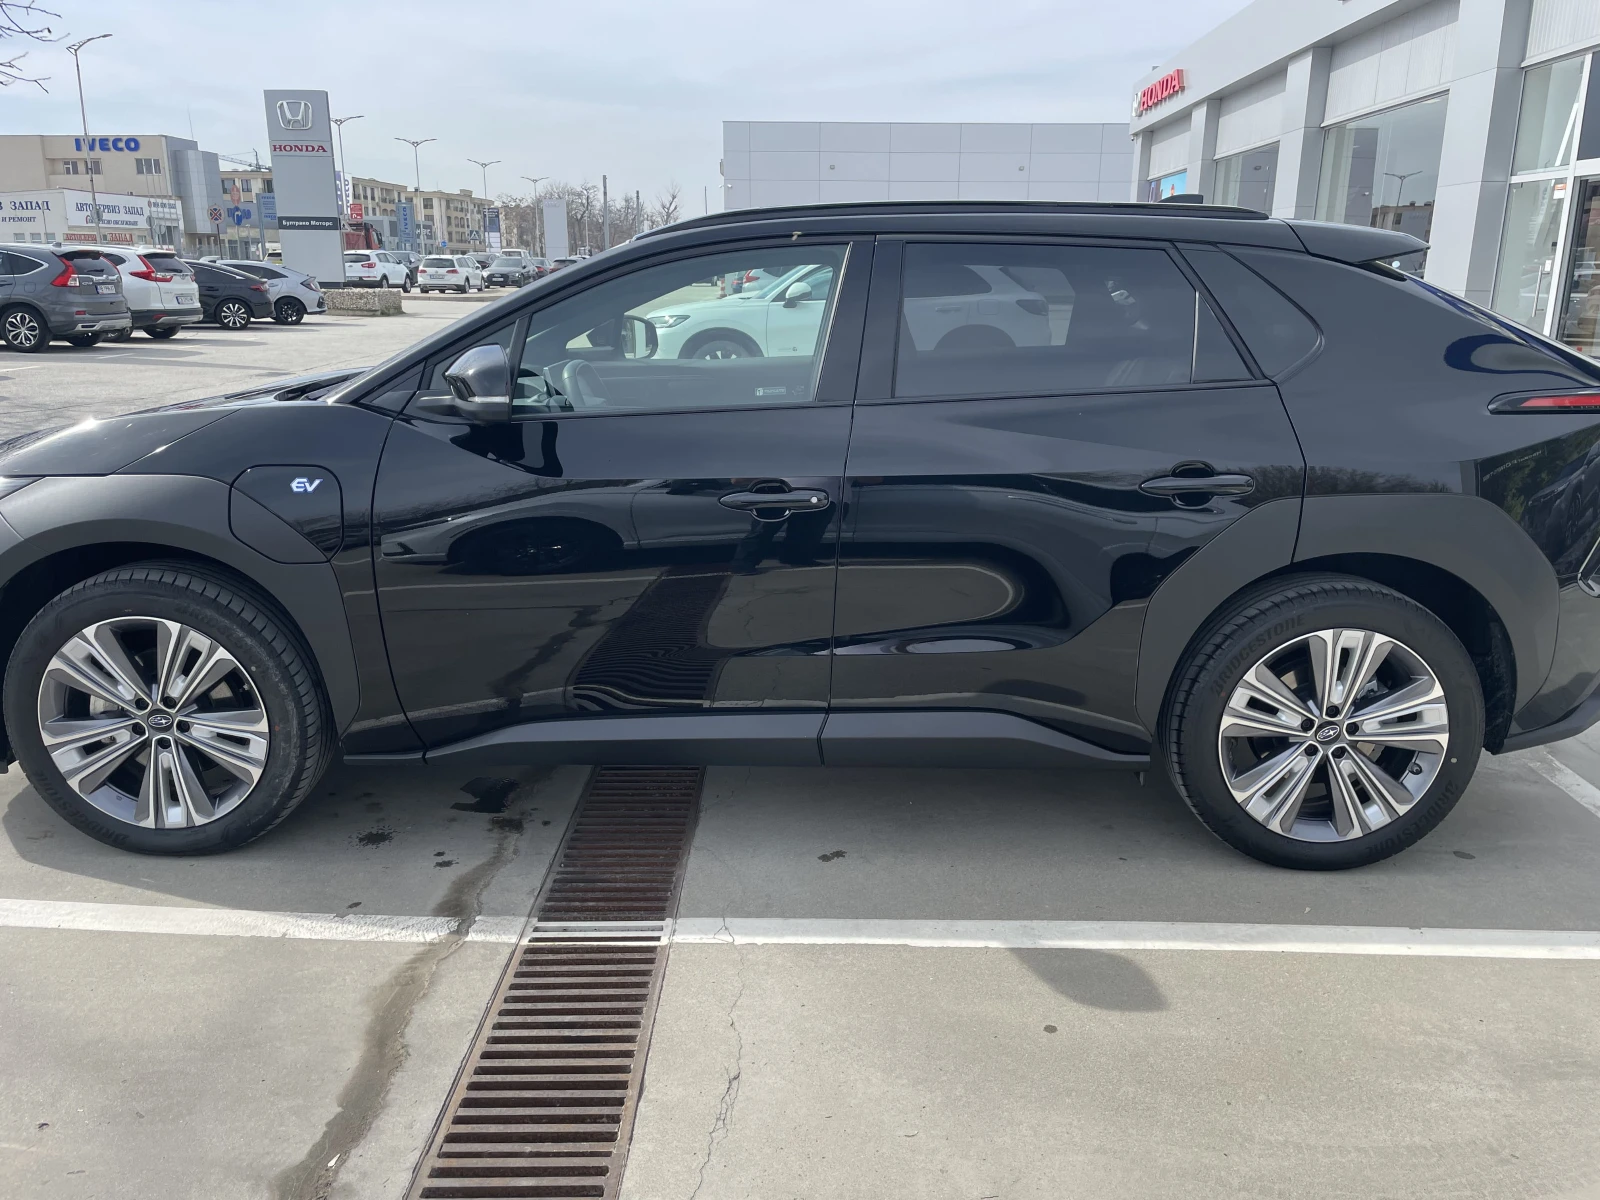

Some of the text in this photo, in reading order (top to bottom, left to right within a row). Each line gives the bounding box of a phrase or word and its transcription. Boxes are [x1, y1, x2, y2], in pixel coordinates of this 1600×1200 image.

[1140, 69, 1186, 111] HONDA
[75, 138, 140, 152] IVECO
[272, 145, 328, 153] HONDA
[10, 201, 51, 211] ЗАПАД
[75, 202, 144, 216] АВТОЕРВИЗ ЗАПАД
[290, 477, 323, 493] EV
